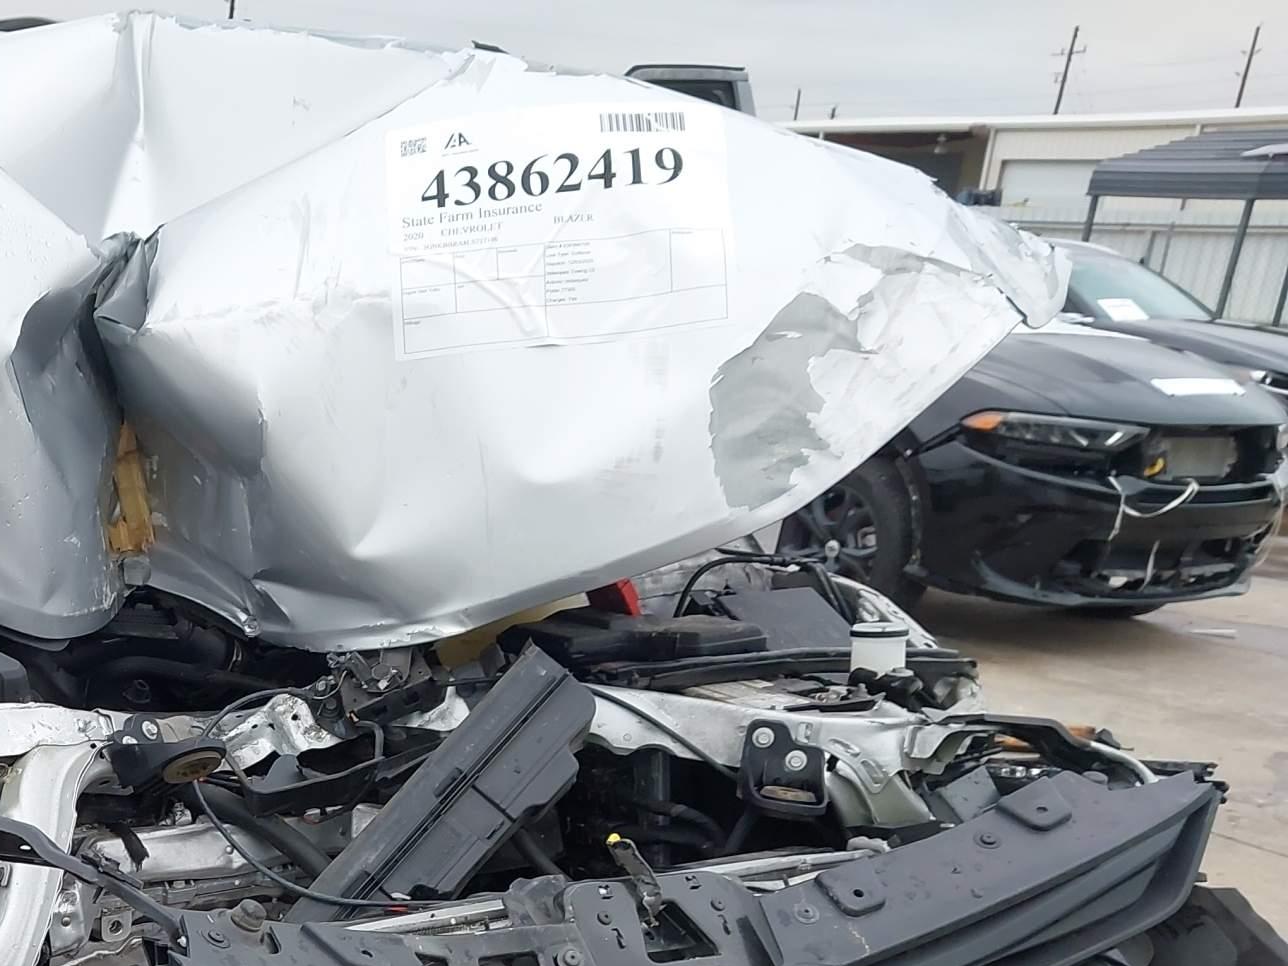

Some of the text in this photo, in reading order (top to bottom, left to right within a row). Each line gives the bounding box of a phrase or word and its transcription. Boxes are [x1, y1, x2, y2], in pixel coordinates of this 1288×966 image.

[421, 146, 684, 208] 43862419
[402, 201, 543, 229] State Farm Insurance
[553, 213, 595, 225] BLAZER
[403, 222, 503, 242] 2020 CHEVROLET
